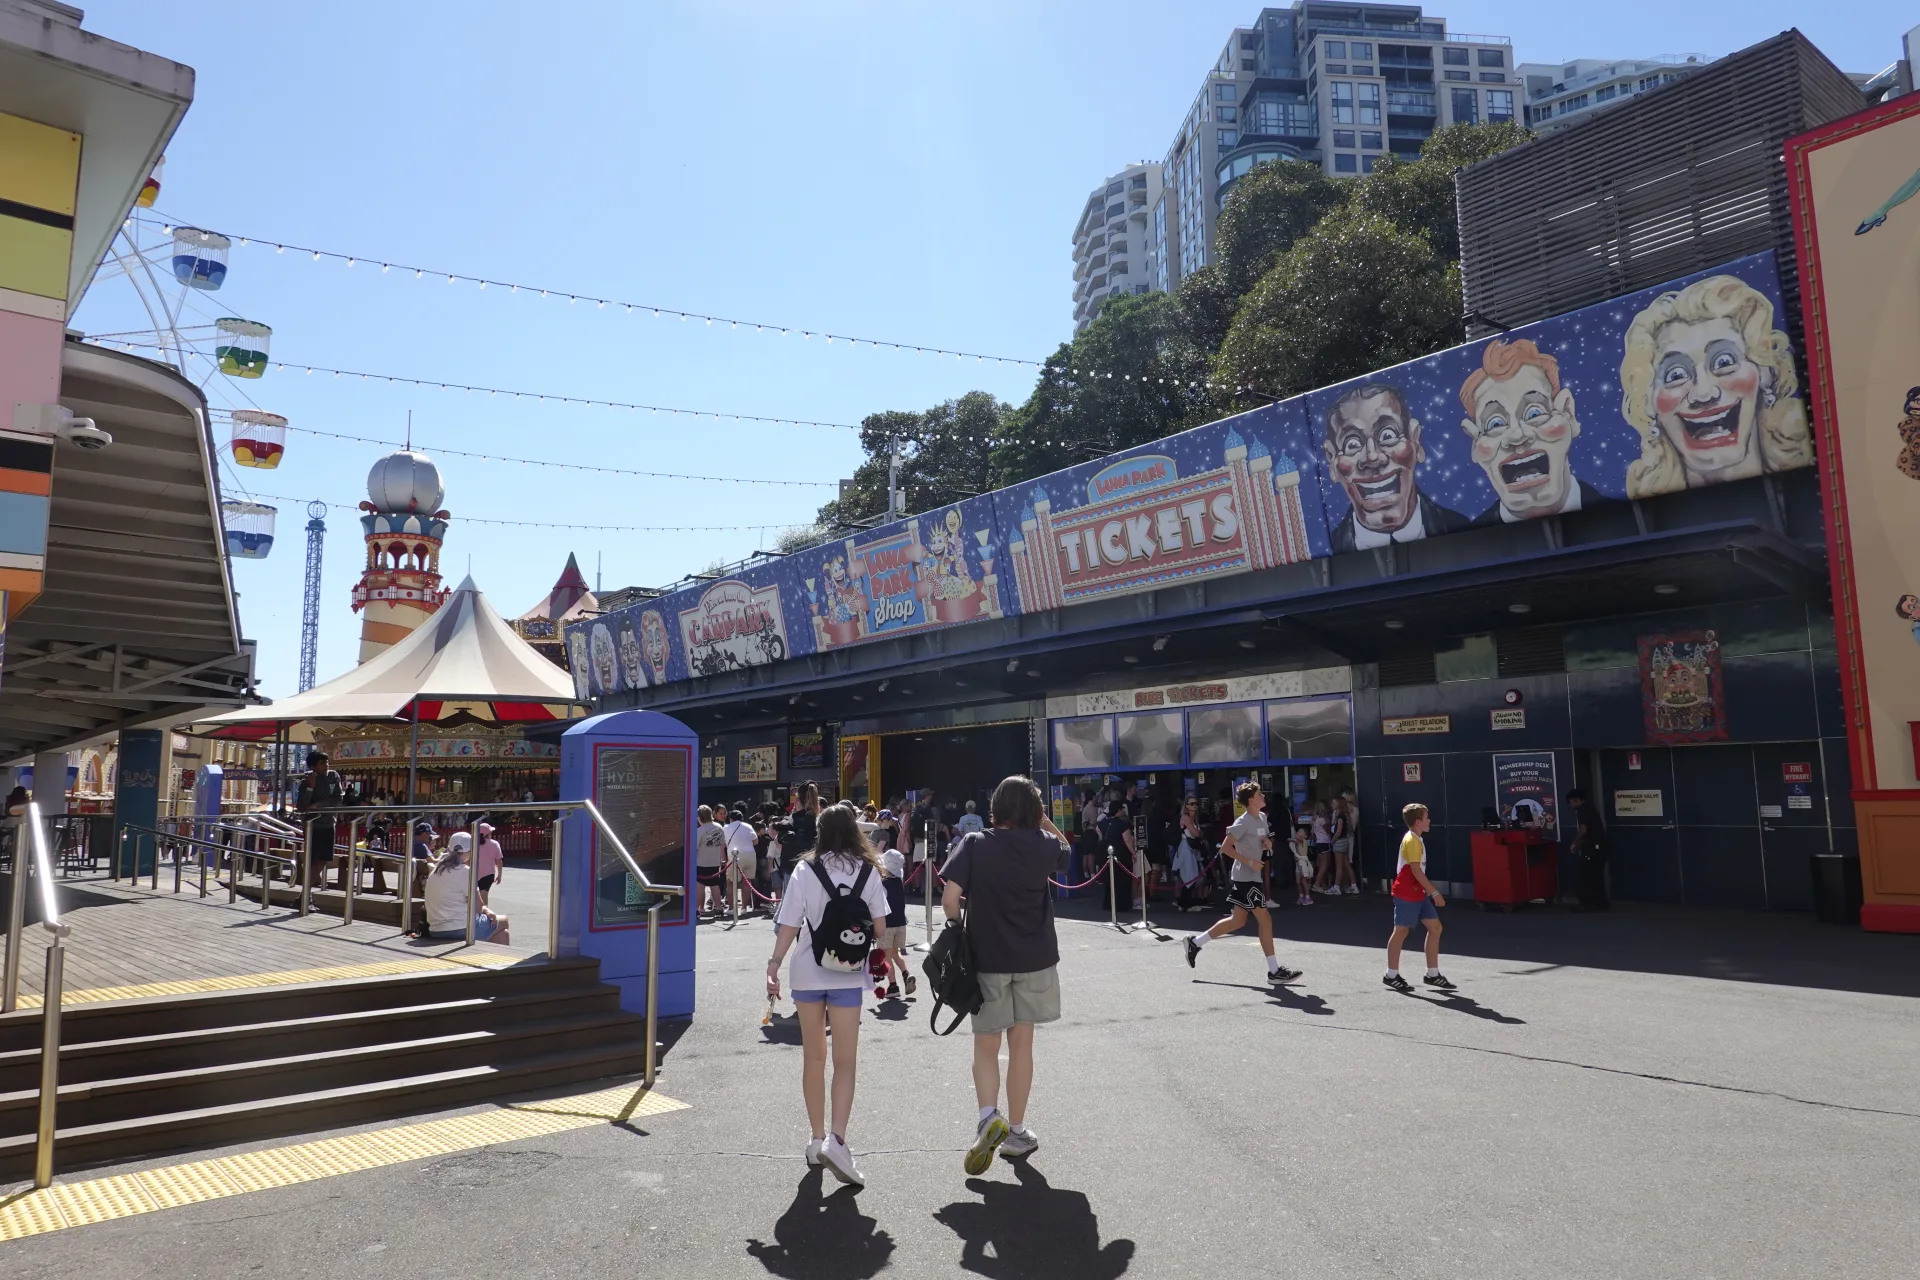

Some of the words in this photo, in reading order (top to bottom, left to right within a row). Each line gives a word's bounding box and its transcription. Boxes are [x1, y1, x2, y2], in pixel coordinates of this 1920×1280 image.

[1095, 473, 1131, 497] LUNA
[1131, 461, 1167, 486] PARK
[1059, 493, 1239, 575] TICKETS
[863, 548, 910, 578] LUNA
[870, 568, 914, 601] PARK
[689, 600, 774, 647] CARPARK
[875, 597, 916, 629] Shop
[1135, 691, 1164, 708] RIDE
[1167, 683, 1228, 703] TICKETS
[1420, 717, 1447, 725] RELATIONS
[1499, 762, 1534, 771] MEMBERSHIP
[1499, 777, 1521, 785] ANNUAL
